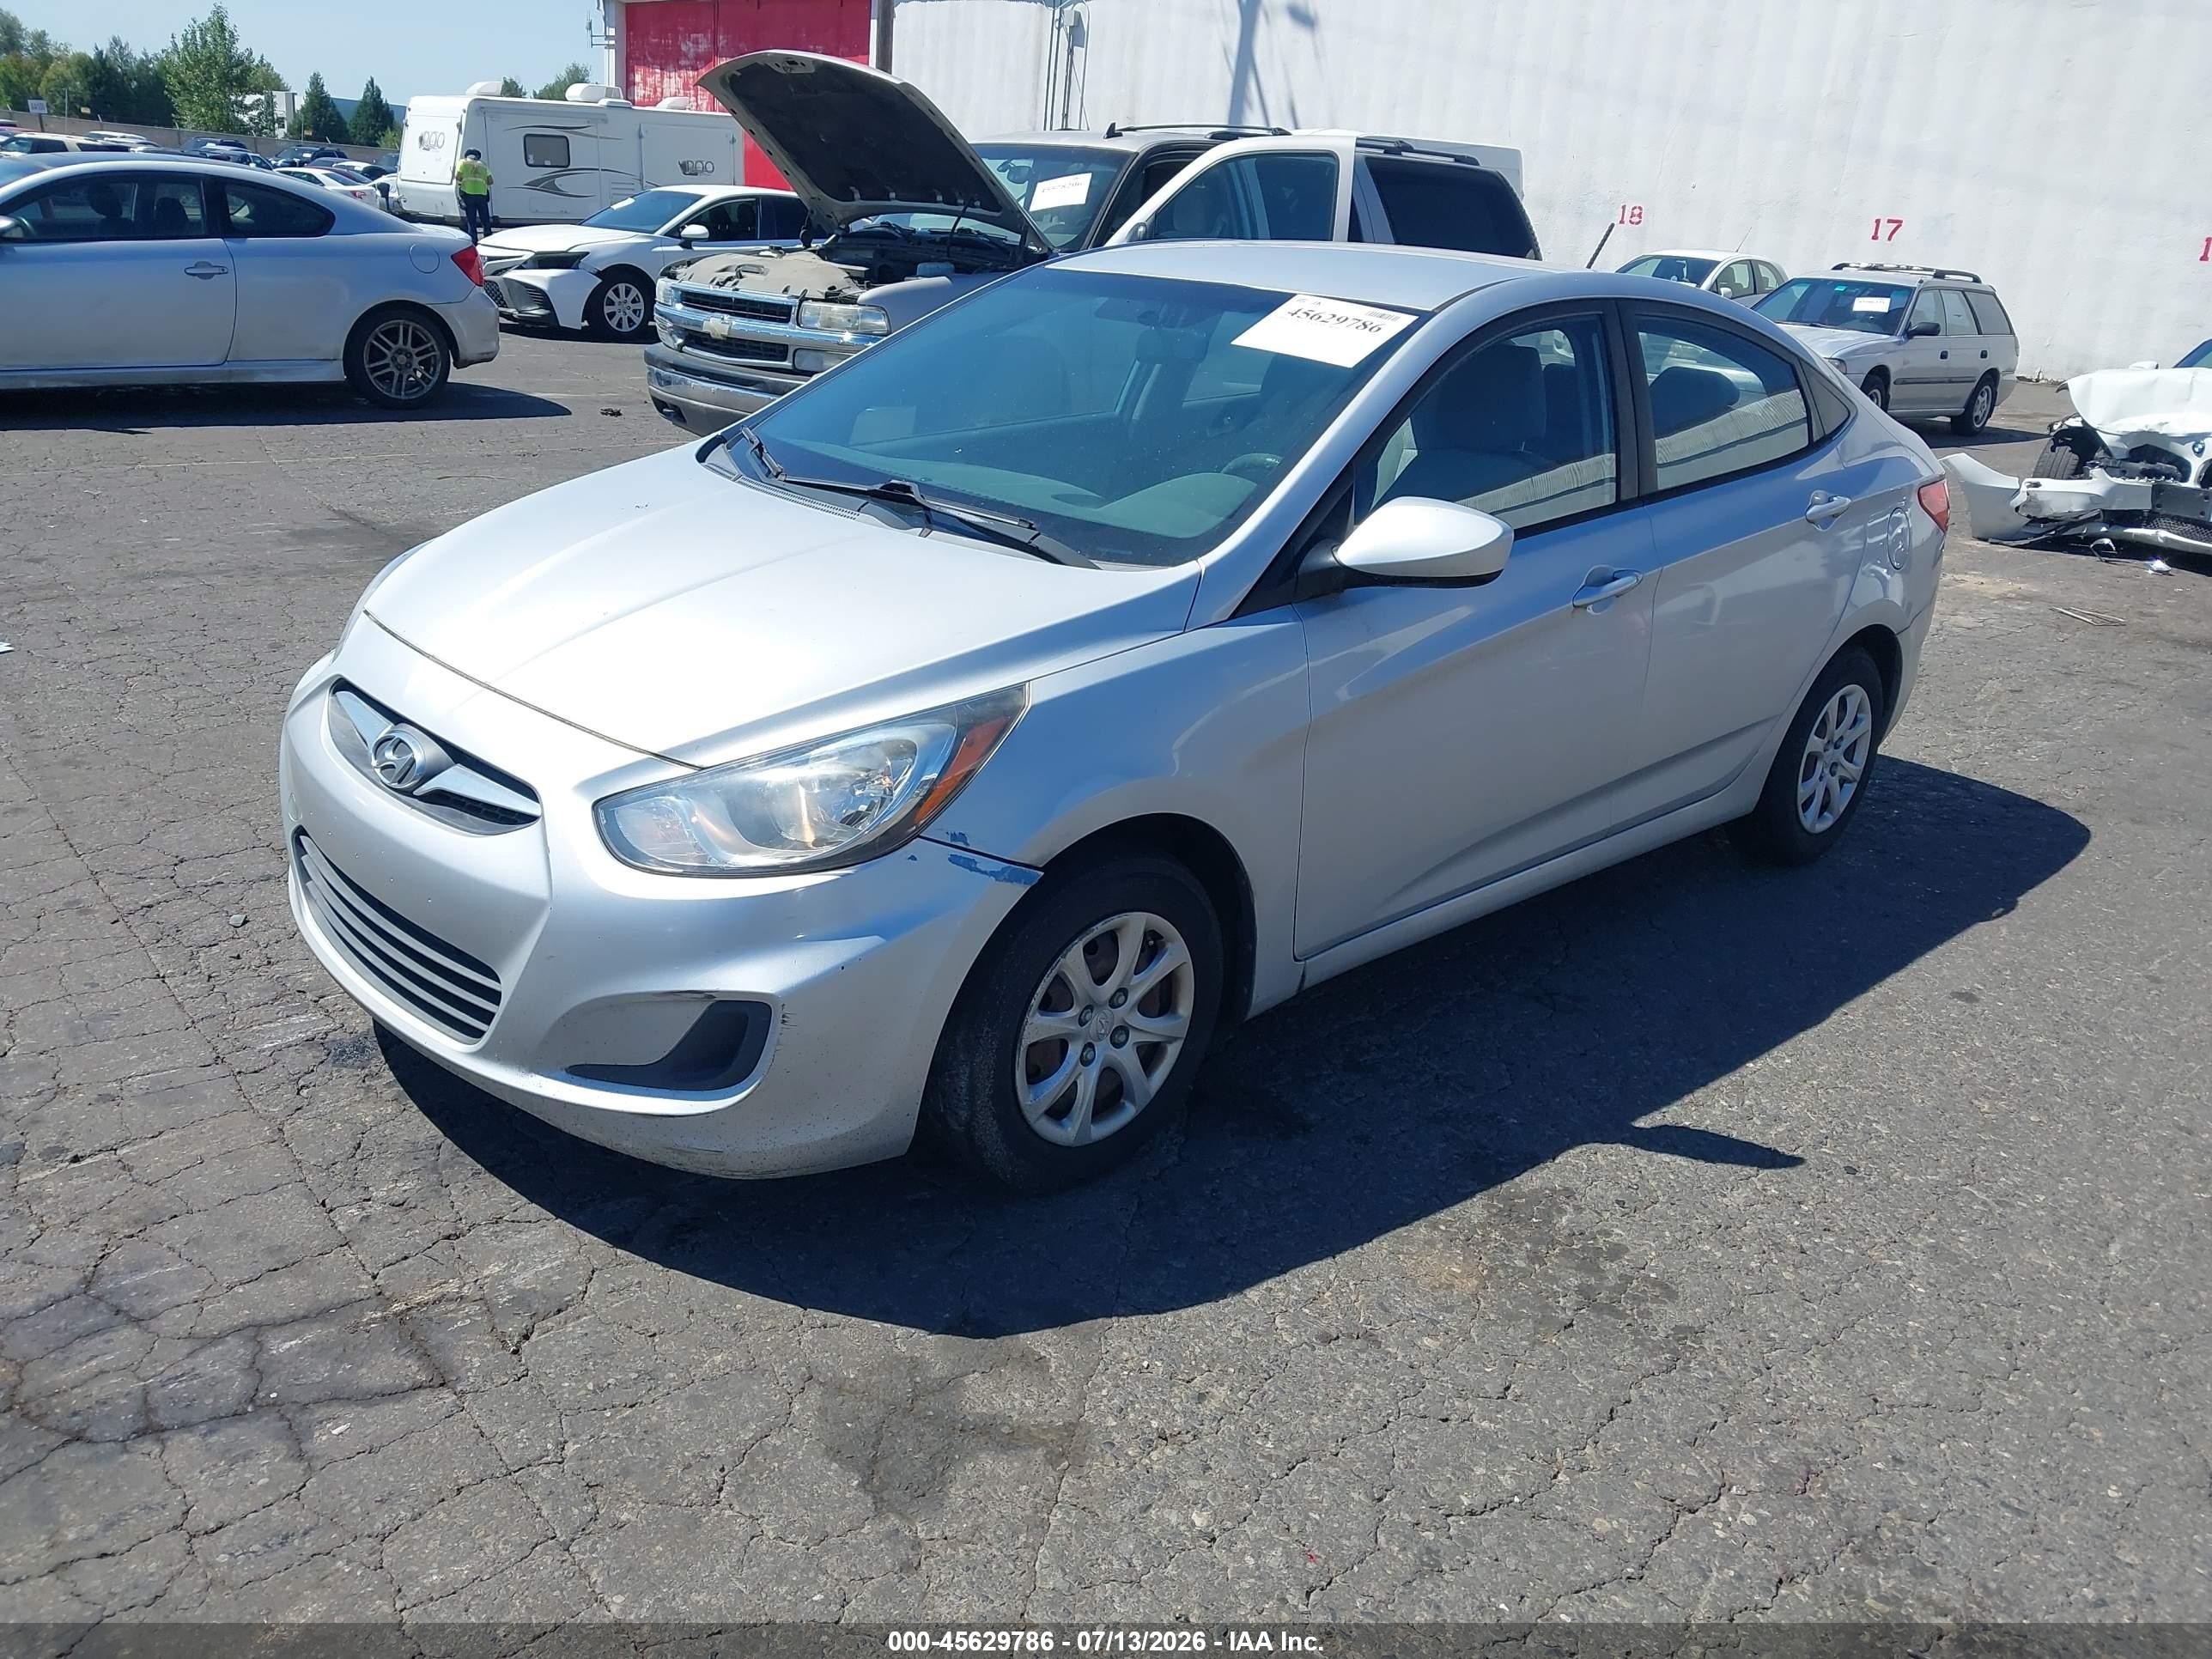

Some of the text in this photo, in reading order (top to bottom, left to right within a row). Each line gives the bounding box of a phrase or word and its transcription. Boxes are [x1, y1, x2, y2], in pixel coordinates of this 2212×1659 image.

[1619, 204, 1644, 226] 18
[1871, 218, 1904, 241] 17
[1287, 307, 1386, 333] 45629786
